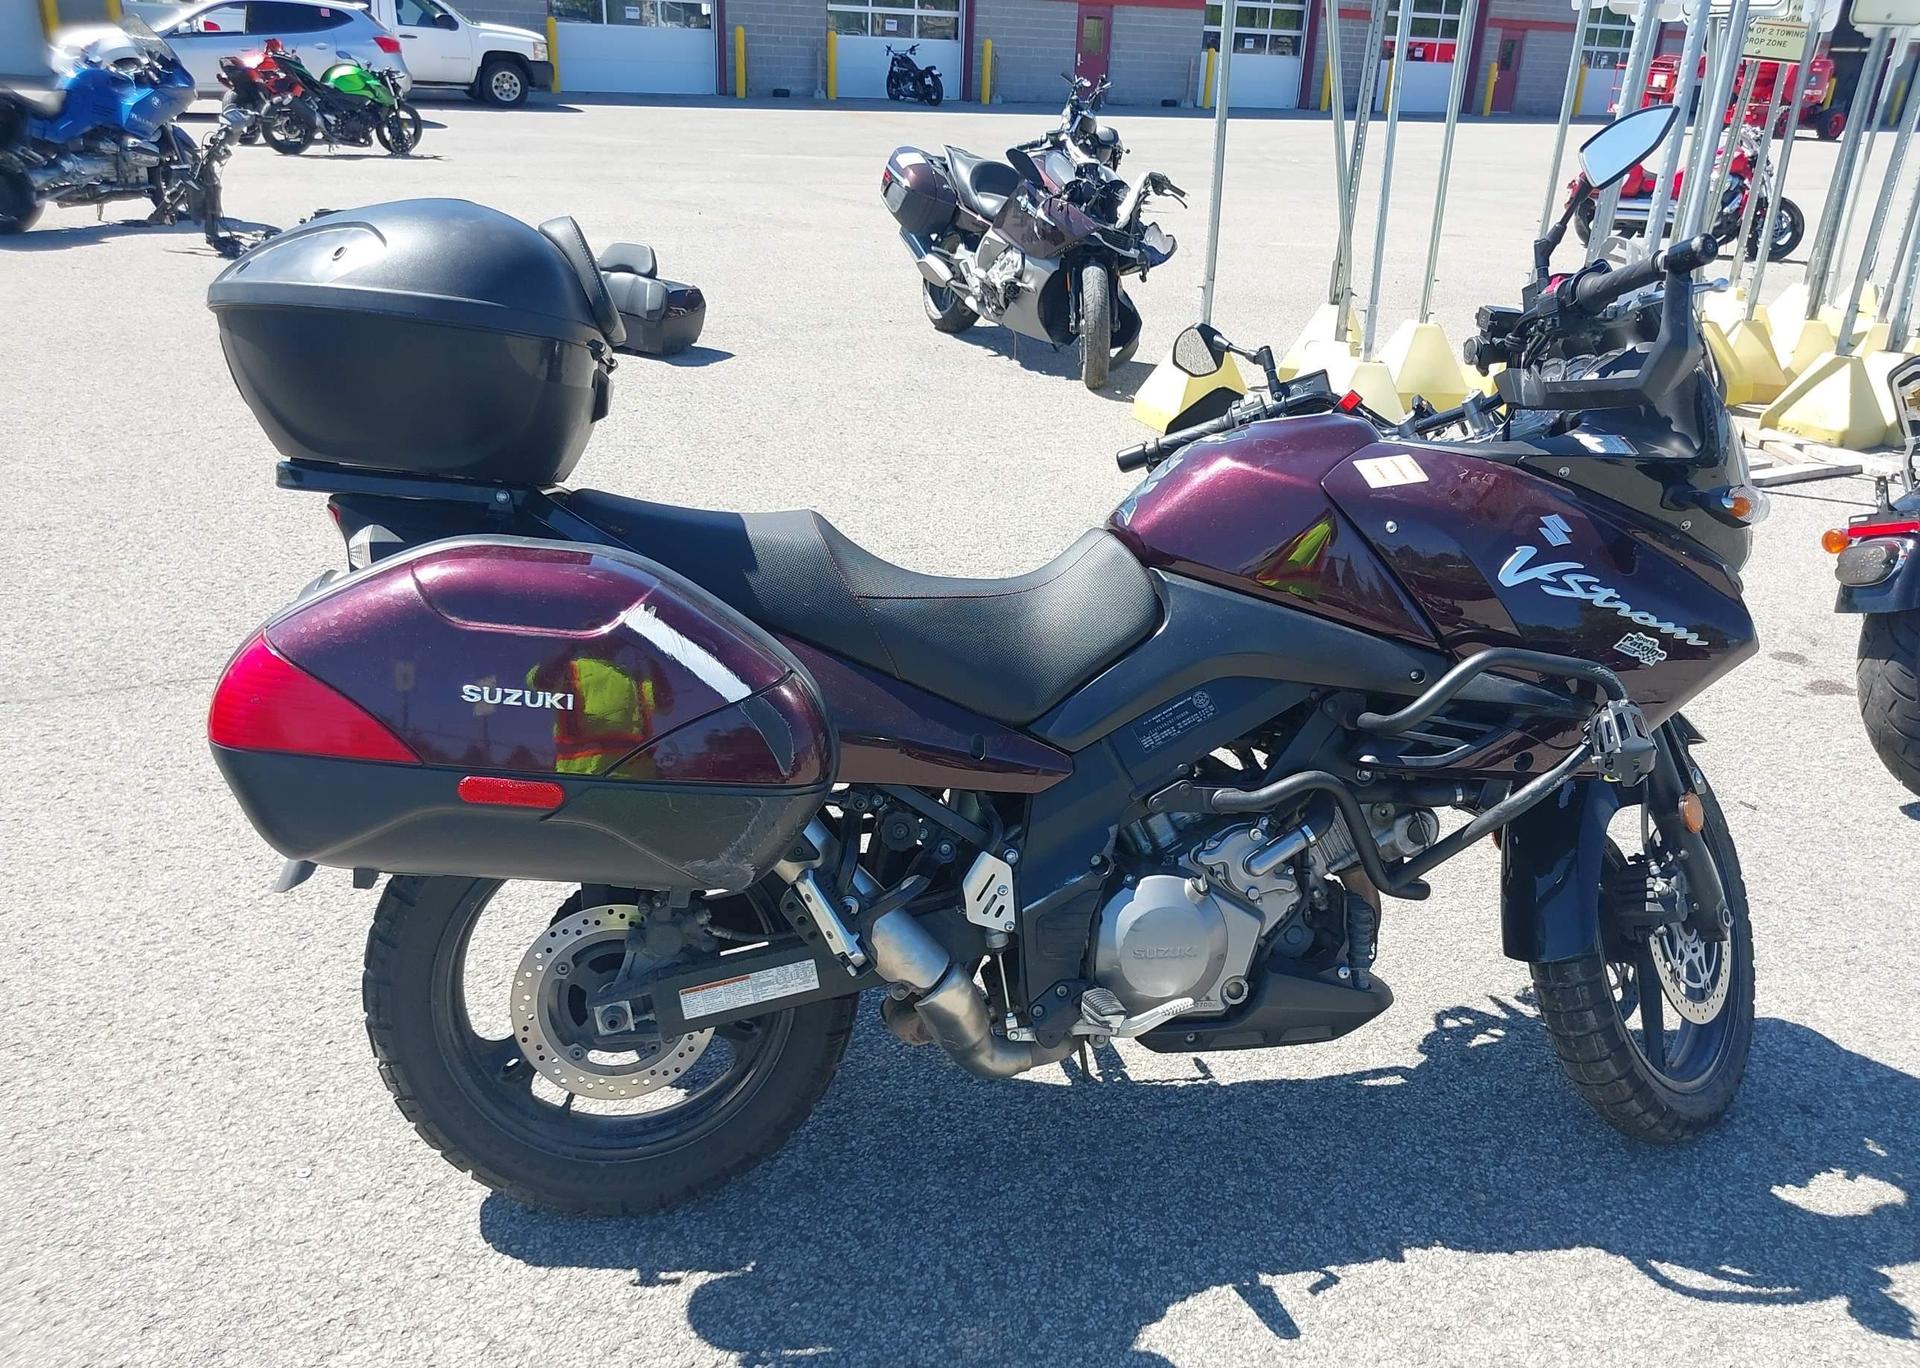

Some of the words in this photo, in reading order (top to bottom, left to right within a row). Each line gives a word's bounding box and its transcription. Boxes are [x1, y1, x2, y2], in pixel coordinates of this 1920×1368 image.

[1756, 27, 1767, 35] OF
[1768, 28, 1774, 36] 2
[1766, 39, 1788, 48] ZONE
[461, 684, 575, 711] SUZUKI
